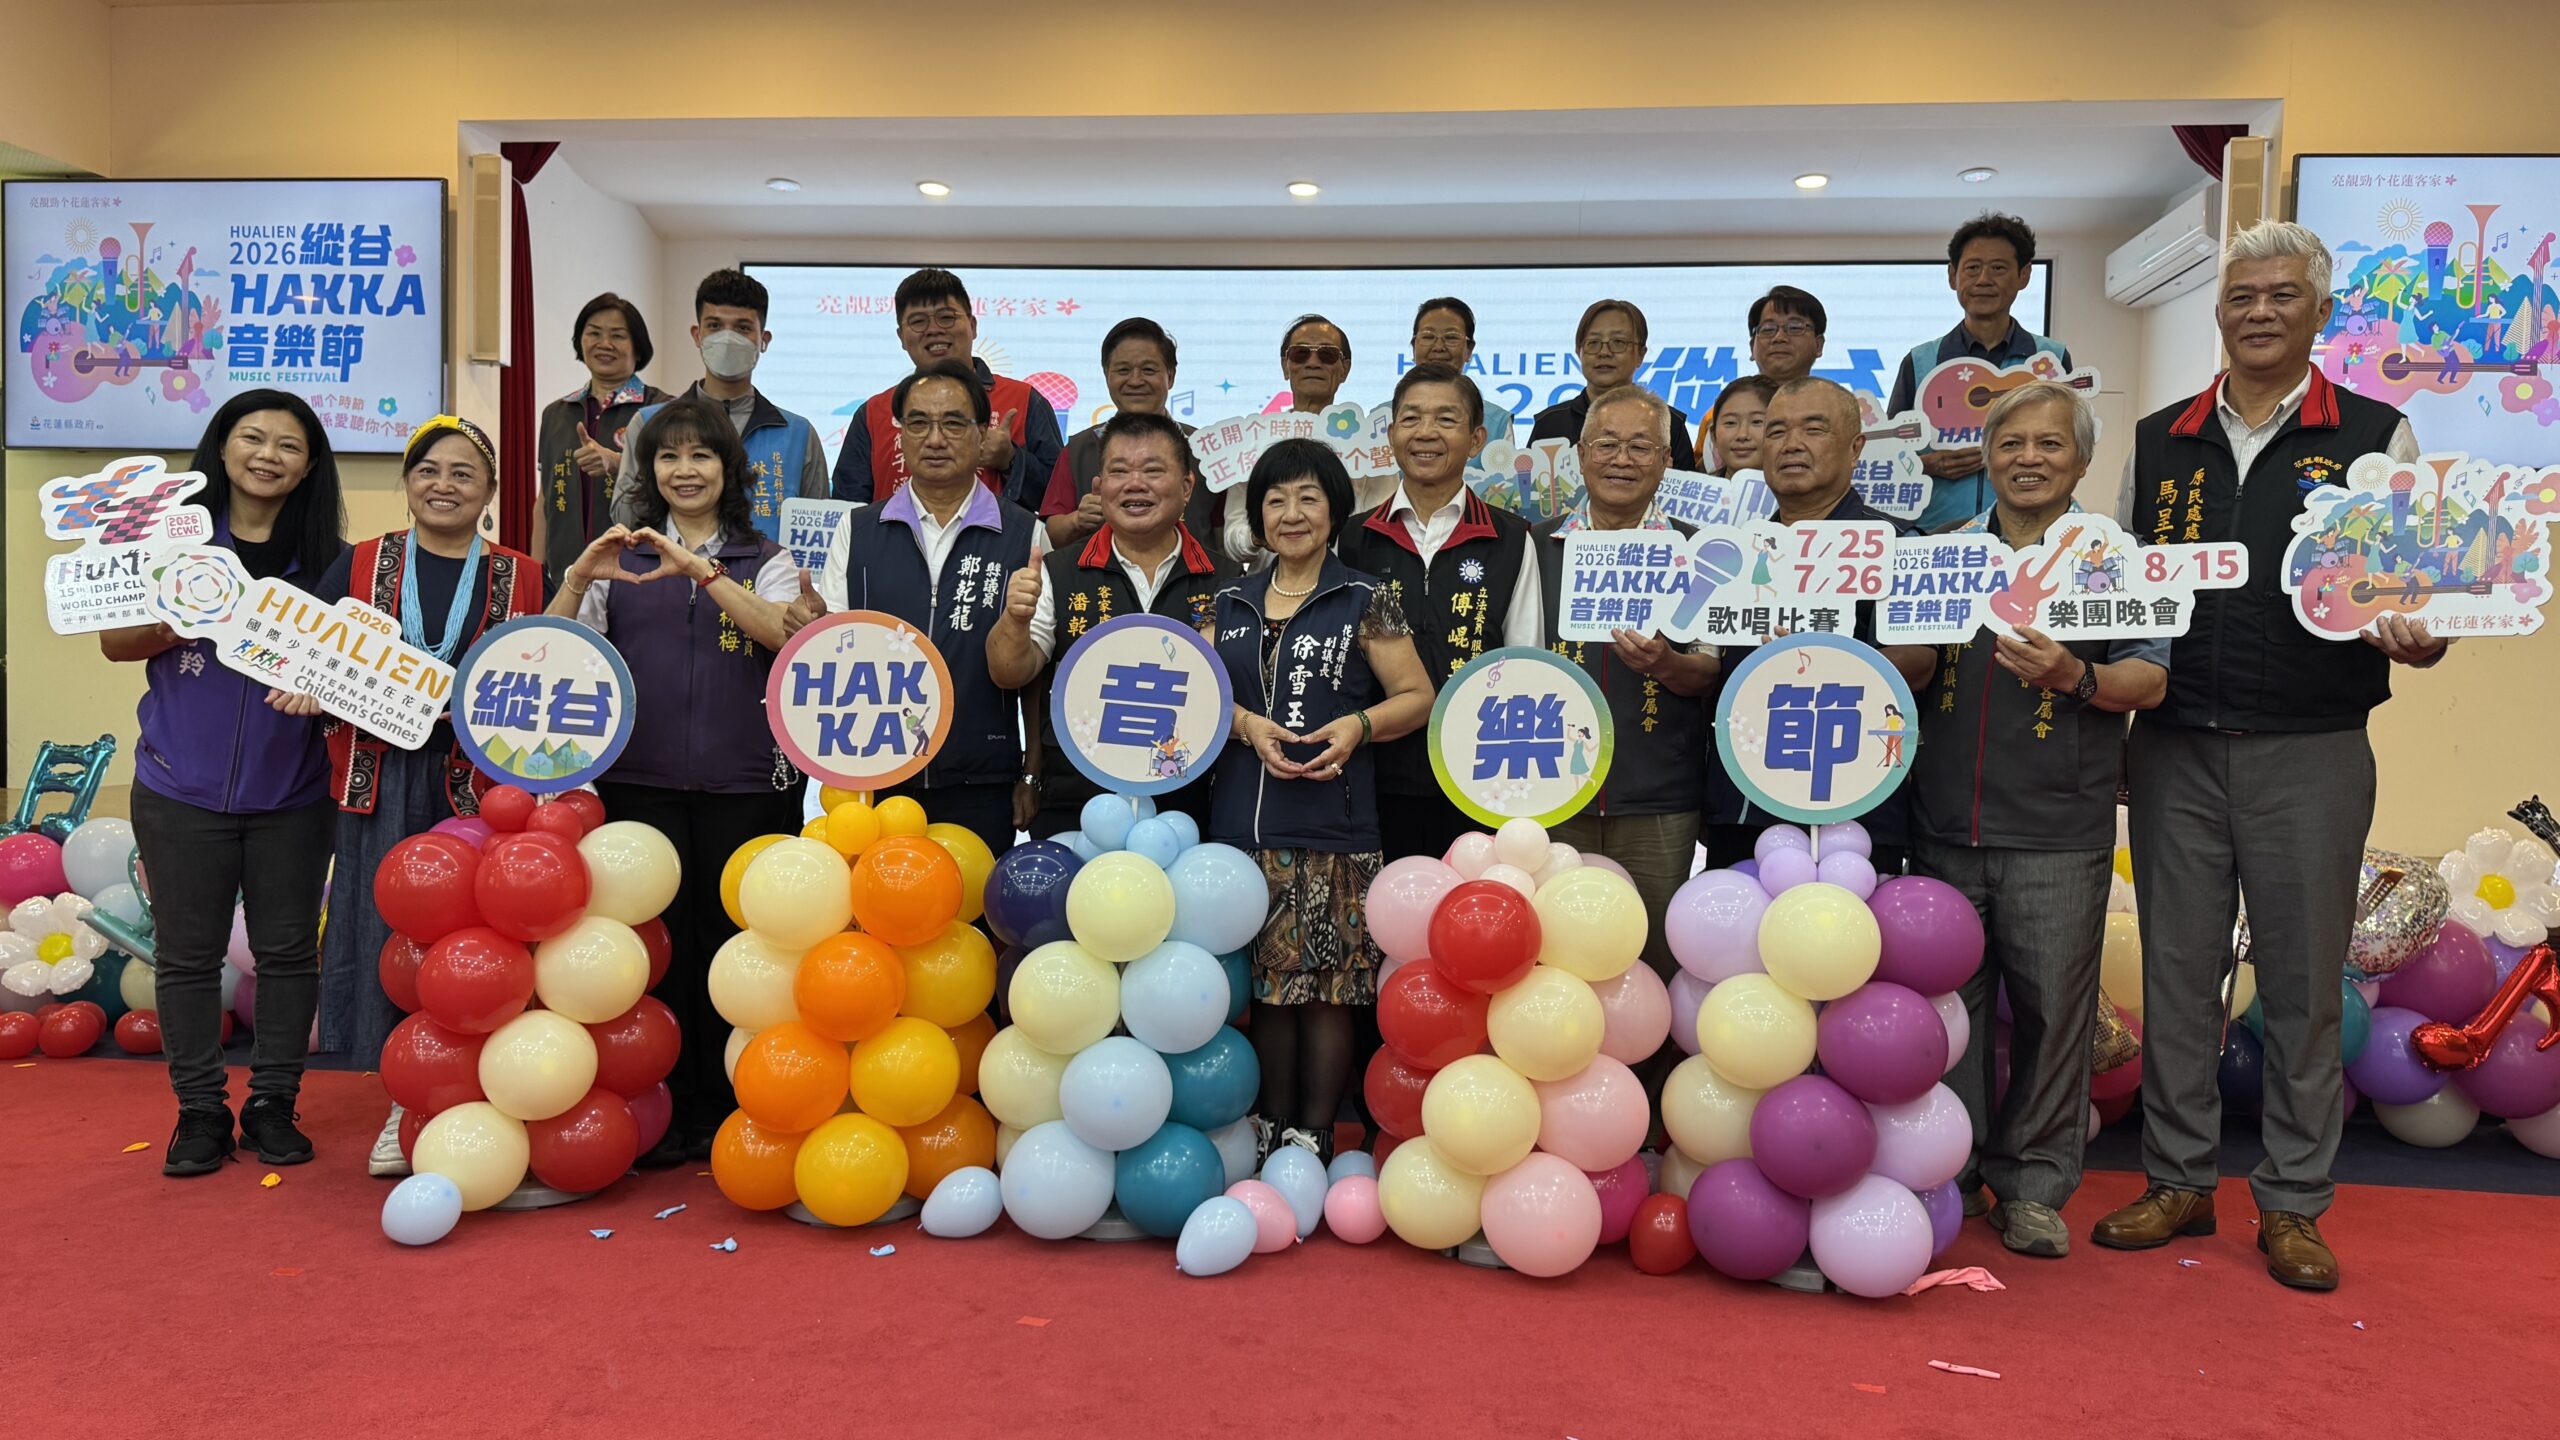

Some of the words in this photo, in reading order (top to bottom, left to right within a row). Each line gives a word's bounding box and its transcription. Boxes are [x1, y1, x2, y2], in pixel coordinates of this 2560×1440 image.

[230, 225, 296, 239] HUALIEN
[299, 223, 392, 267] 縱谷
[229, 241, 296, 265] 2026
[230, 273, 426, 317] HAKKA
[227, 323, 365, 382] 音樂節
[229, 371, 271, 382] MUSIC
[277, 371, 338, 383] FESTIVAL
[169, 515, 198, 527] 2026
[790, 515, 822, 528] 2026
[791, 508, 823, 517] HUALIEN
[170, 525, 201, 537] CCWC
[1795, 528, 1885, 559] 7/25
[1575, 552, 1616, 566] 2026
[1576, 543, 1616, 552] HUALIEN
[1616, 543, 1673, 567] 縱谷
[1895, 548, 1930, 557] UALIEN
[1931, 545, 1988, 569] 縱谷
[1793, 563, 1883, 595] 7/26
[2144, 549, 2240, 583] 8/15
[90, 582, 120, 594] IDBF
[948, 553, 982, 632] 鄭乾龍
[981, 561, 1002, 609] 縣議員
[1573, 569, 1691, 595] HAKKA
[1889, 570, 2010, 596] HAKKA
[60, 600, 104, 612] WORLD
[347, 604, 393, 636] 2026
[1570, 597, 1654, 631] 音樂節
[1707, 605, 1840, 636] 歌唱比賽
[1888, 598, 1972, 629] 音樂節
[2048, 596, 2181, 629] 樂團晚會
[1570, 623, 1596, 631] MUSIC
[1918, 624, 1956, 632] FESTIVAL
[256, 586, 451, 700] HUALIEN
[245, 617, 434, 719] 國際少年運動會在花蓮
[1284, 633, 1321, 728] 徐雪玉
[299, 665, 425, 731] INTERNATIONAL
[791, 661, 928, 708] HAK
[294, 675, 369, 720] Children's
[369, 710, 420, 744] Games
[470, 669, 613, 737] 縱谷
[1097, 662, 1190, 749] 音
[817, 711, 907, 758] KA
[1472, 692, 1567, 781] 樂
[1764, 683, 1865, 802] 節
